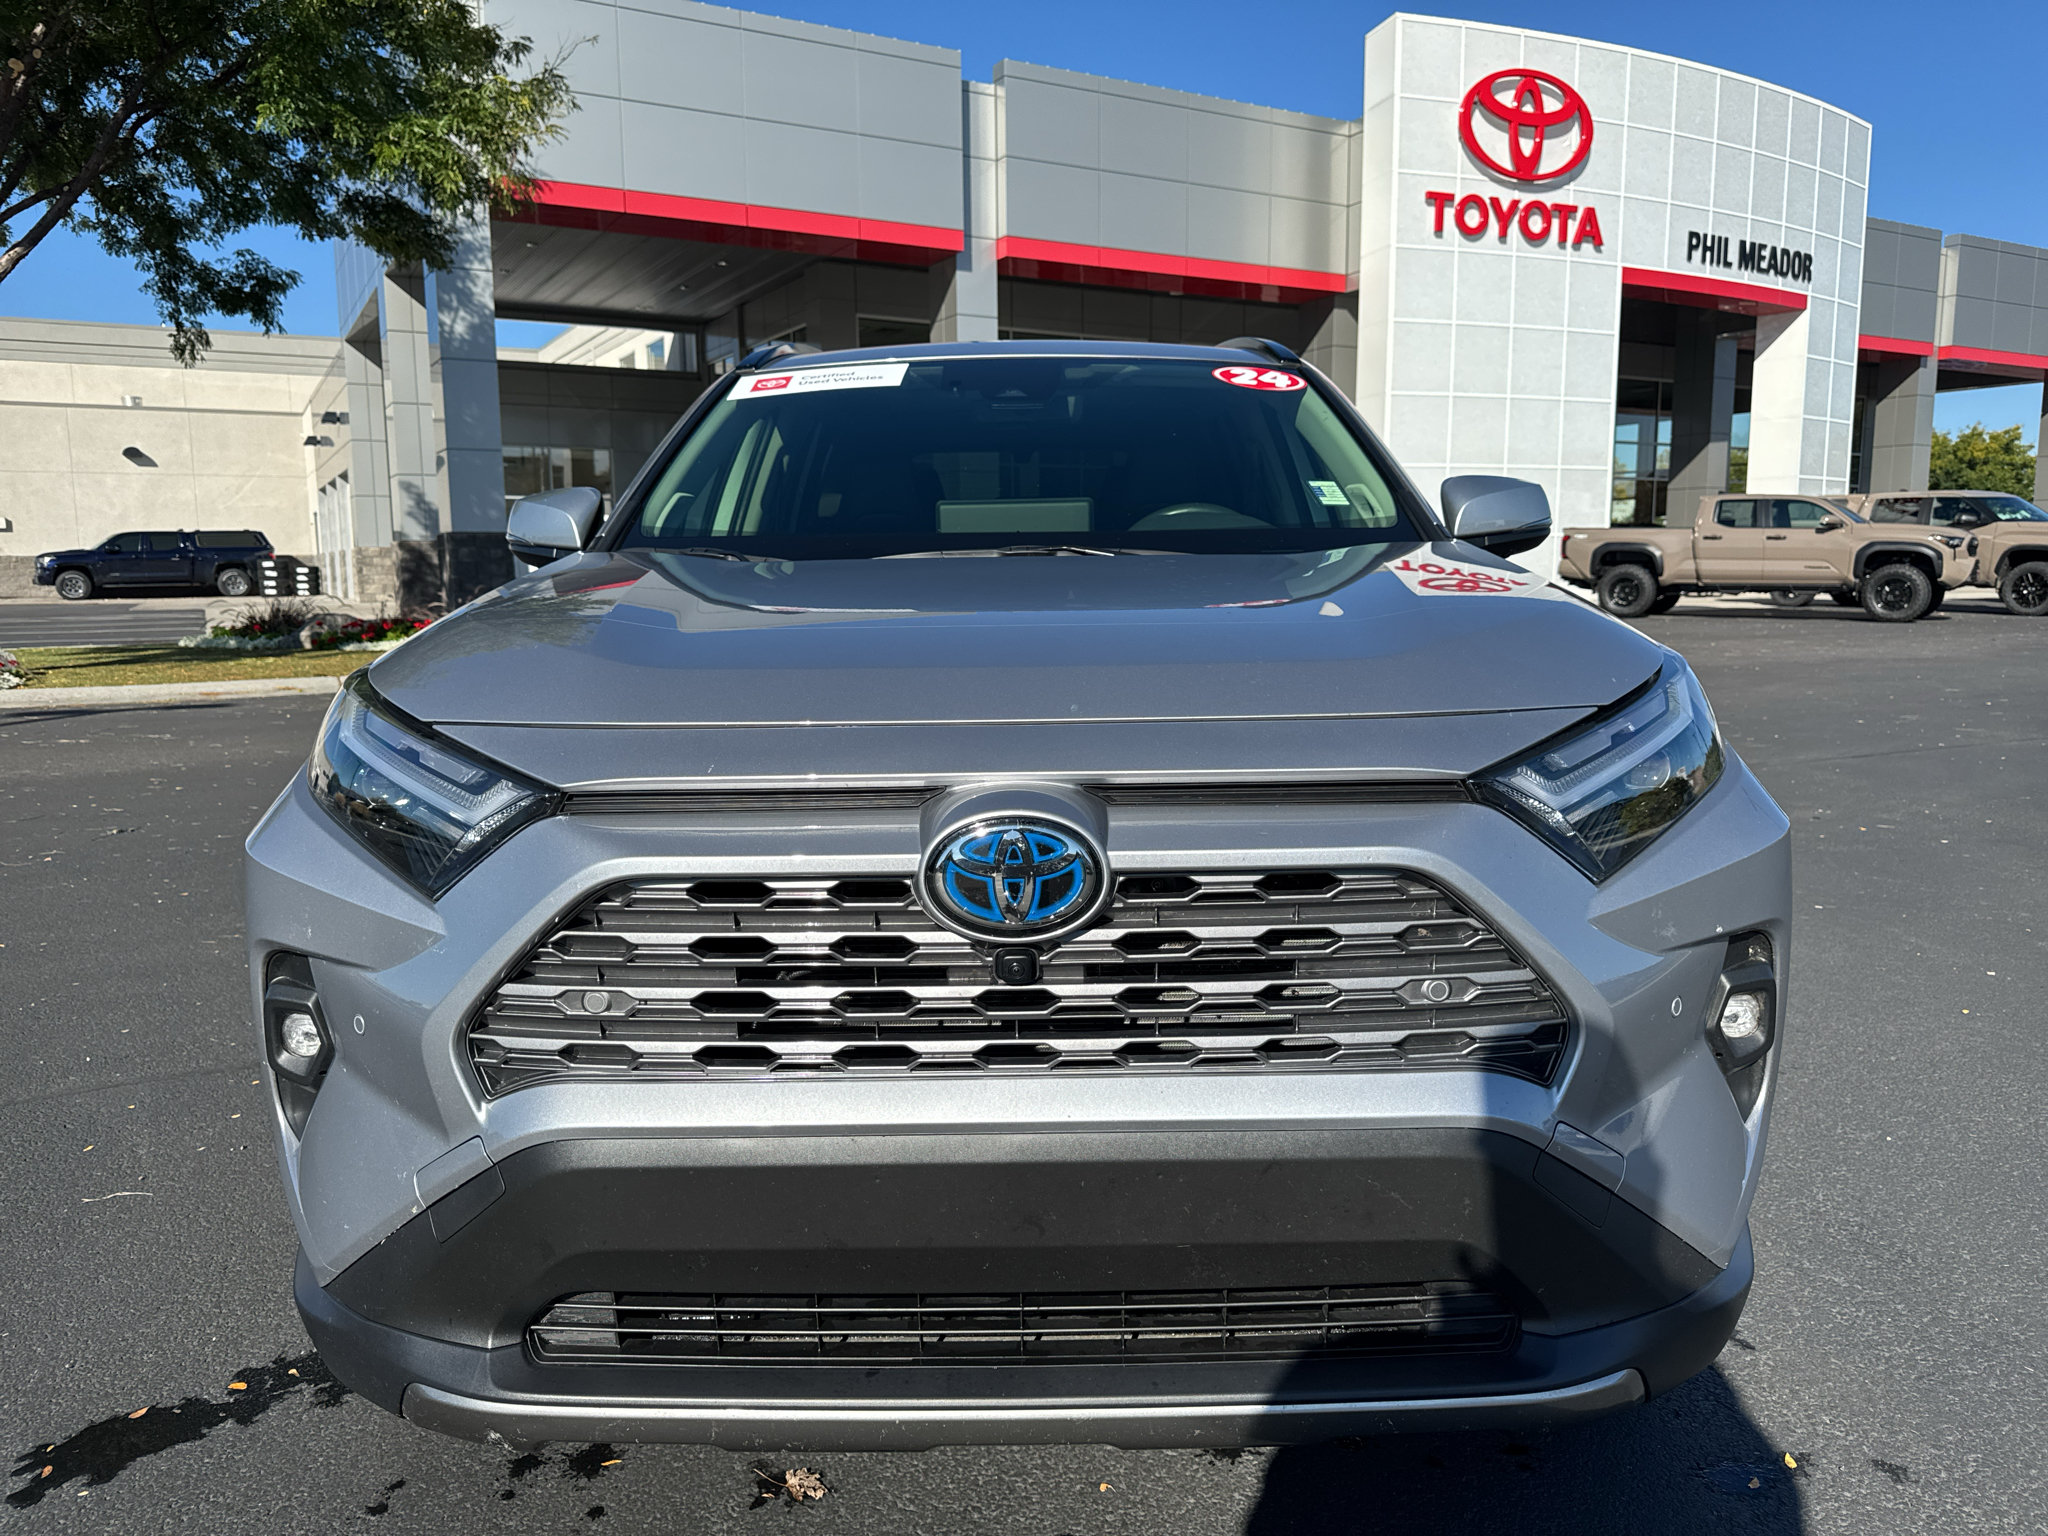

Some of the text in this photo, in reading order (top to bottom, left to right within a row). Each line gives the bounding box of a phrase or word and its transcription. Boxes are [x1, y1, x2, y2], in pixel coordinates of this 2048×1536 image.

[1425, 190, 1604, 247] TOYOTA
[1687, 231, 1813, 283] PHIL MEADOR
[799, 375, 884, 386] Used Vehicles
[801, 371, 855, 380] Certified
[1229, 369, 1291, 388] 24
